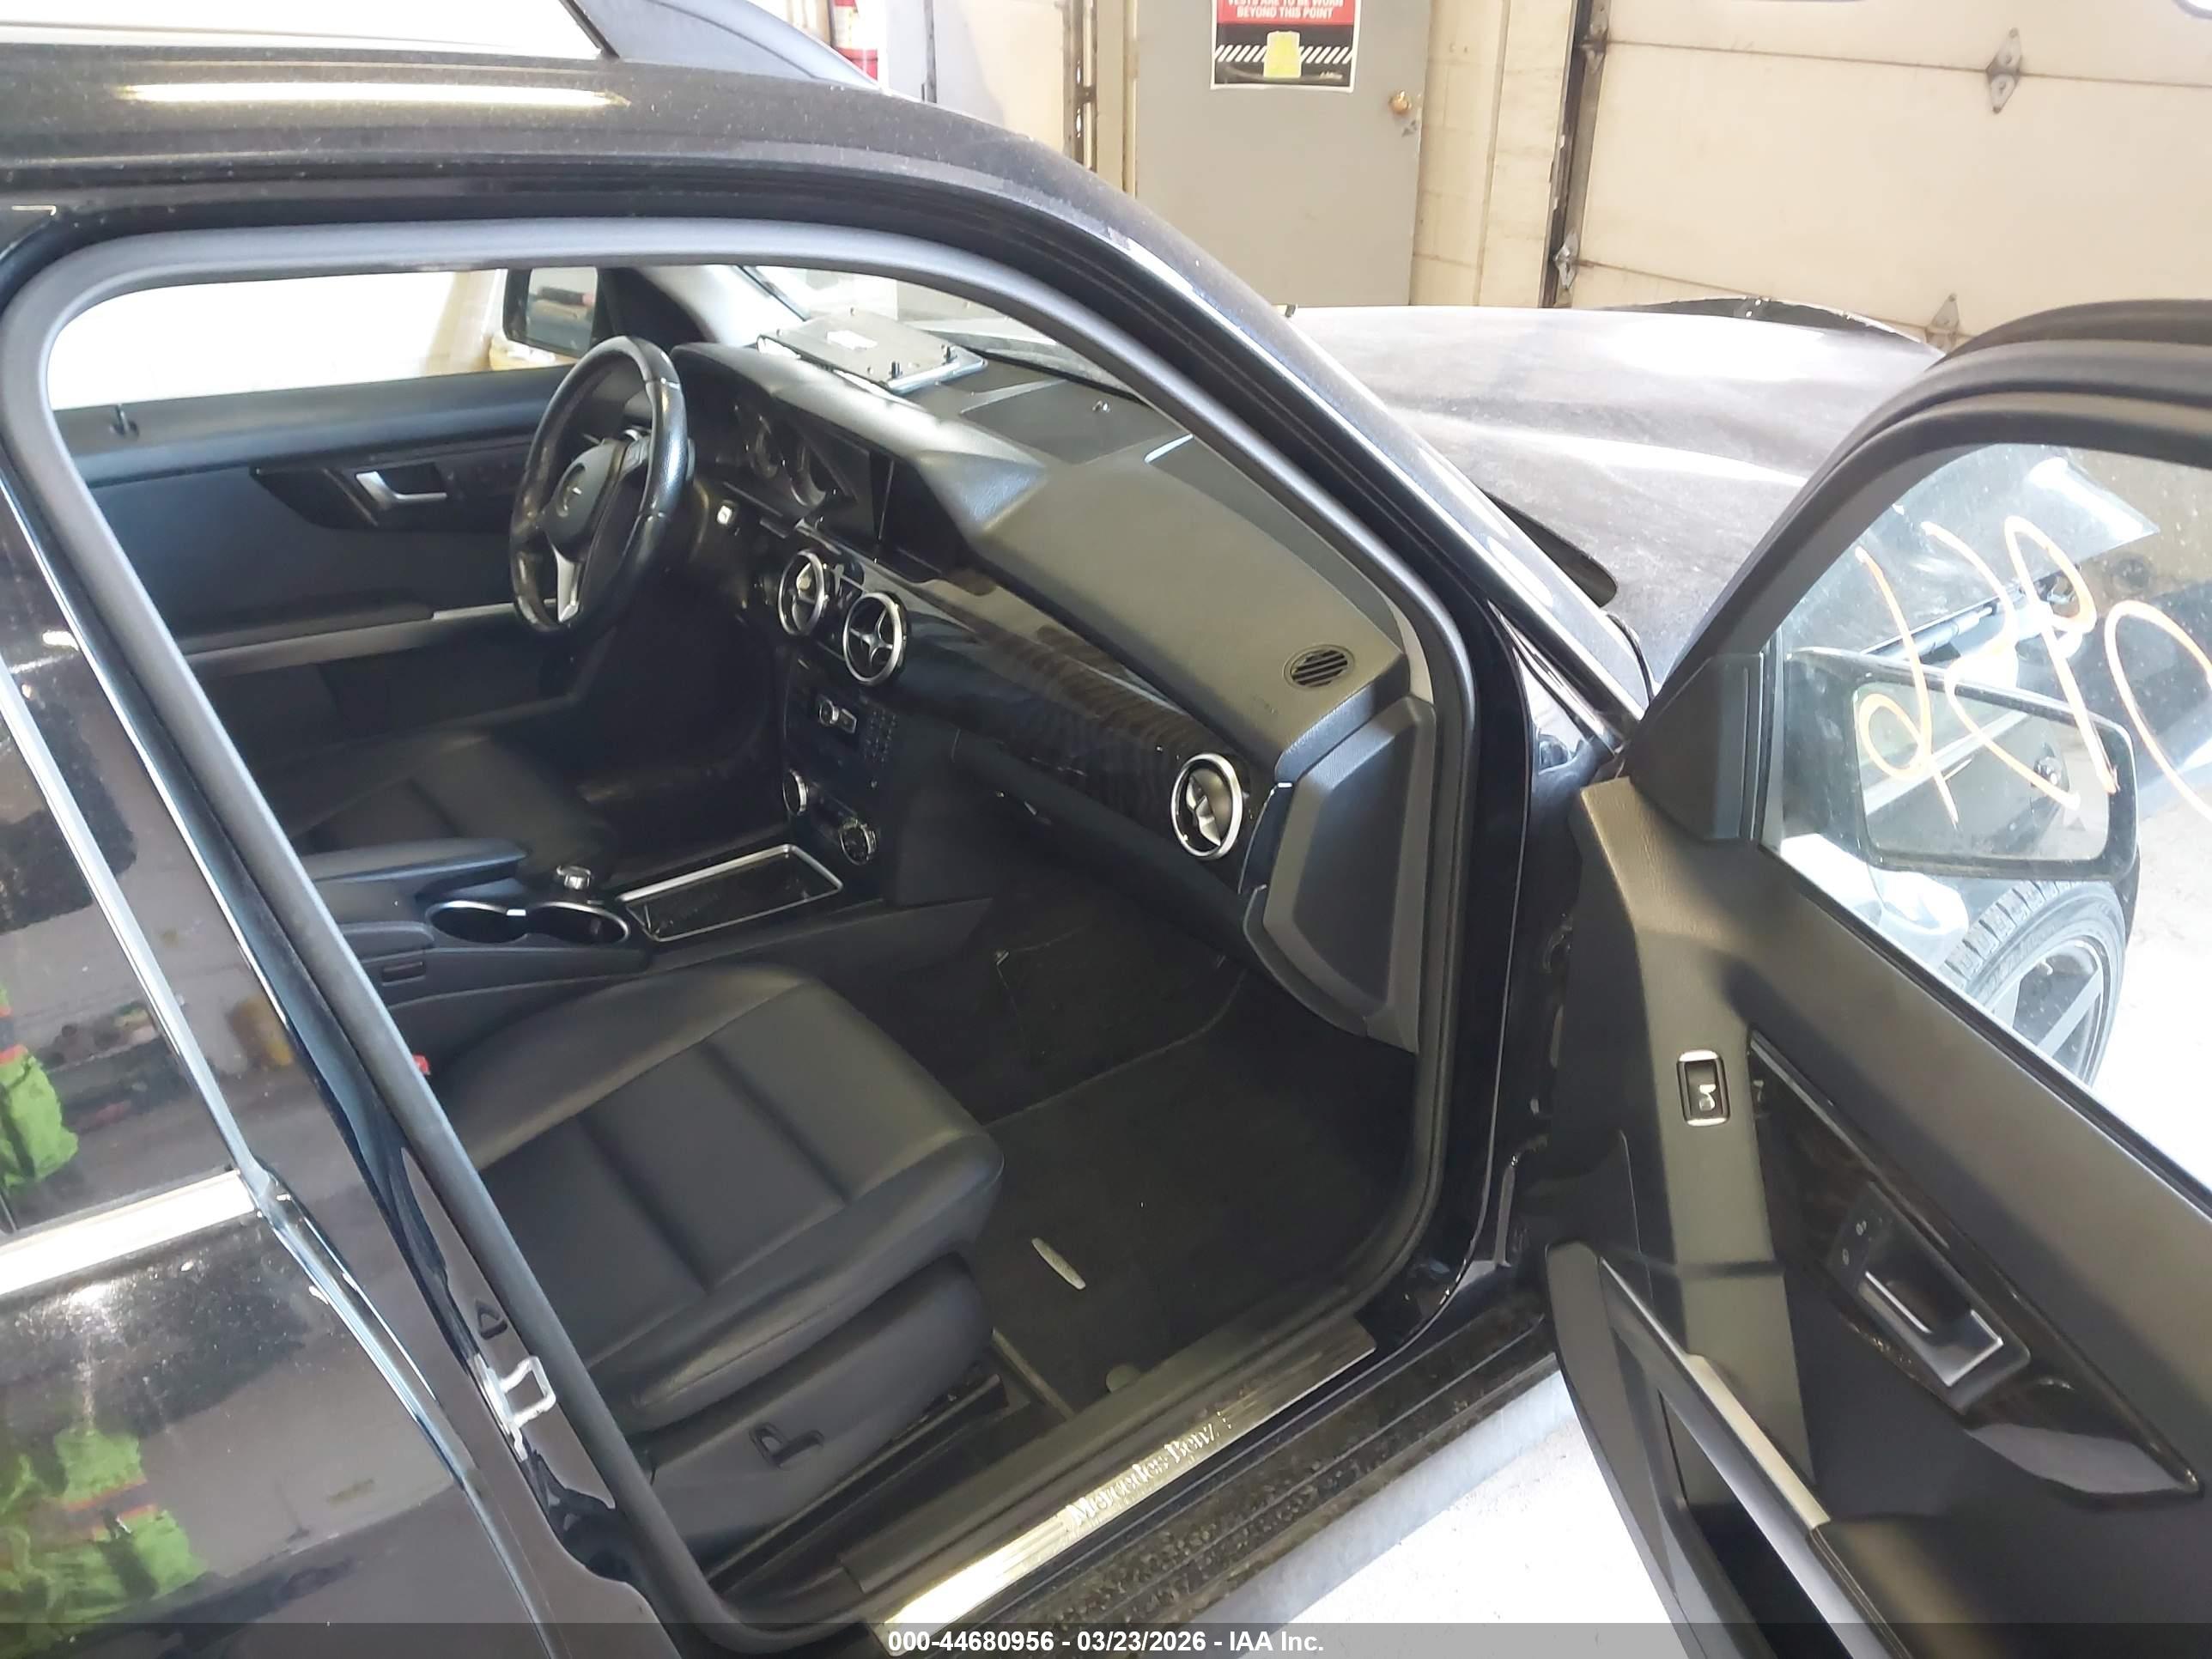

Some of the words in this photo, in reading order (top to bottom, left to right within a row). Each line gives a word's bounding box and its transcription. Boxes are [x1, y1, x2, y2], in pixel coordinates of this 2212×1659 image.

[1237, 7, 1277, 18] BEYOND
[1279, 7, 1301, 18] THIS
[1302, 7, 1334, 19] POINT
